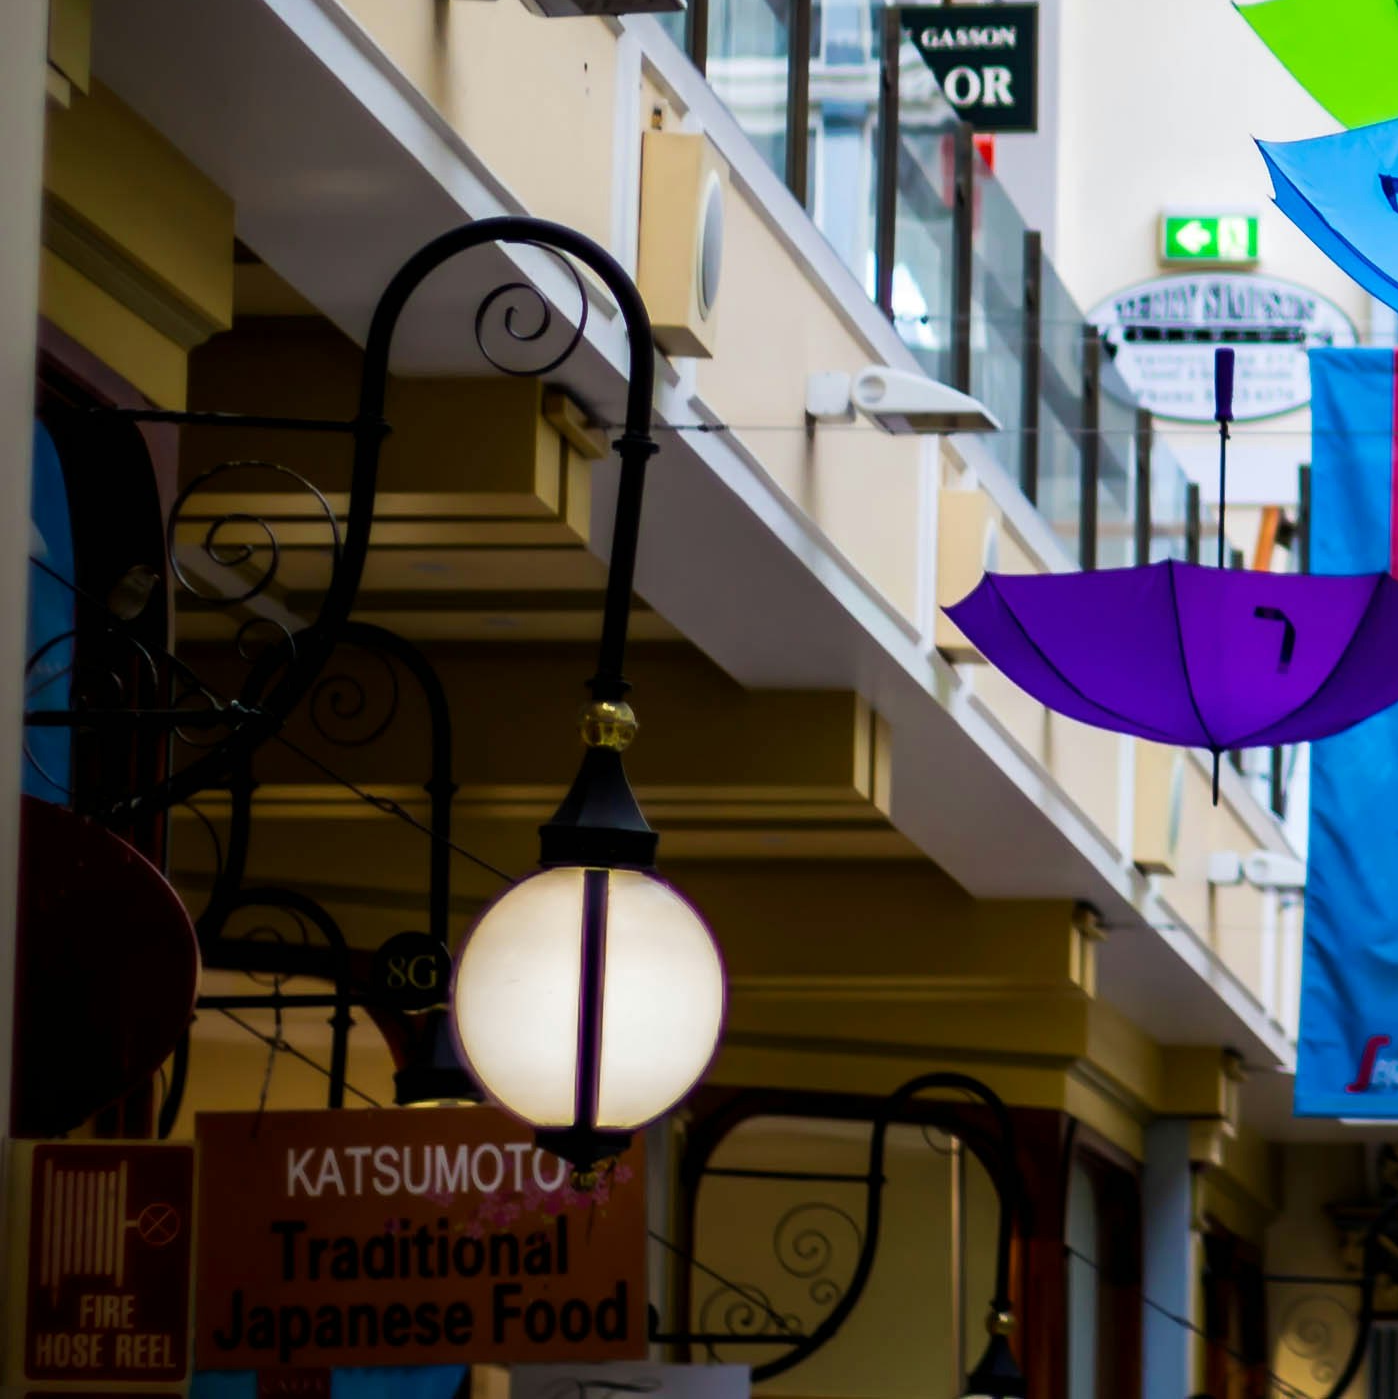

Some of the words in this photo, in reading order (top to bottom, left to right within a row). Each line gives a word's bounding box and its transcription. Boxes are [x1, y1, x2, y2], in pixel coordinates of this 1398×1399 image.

[387, 955, 437, 989] 8G
[287, 1142, 568, 1197] KATSUMOTO
[271, 1214, 569, 1282] Traditional
[79, 1294, 135, 1329] FIRE
[213, 1289, 474, 1363] Japanese
[492, 1280, 628, 1344] Food
[35, 1332, 104, 1368] HOSE
[115, 1333, 177, 1368] REEL
